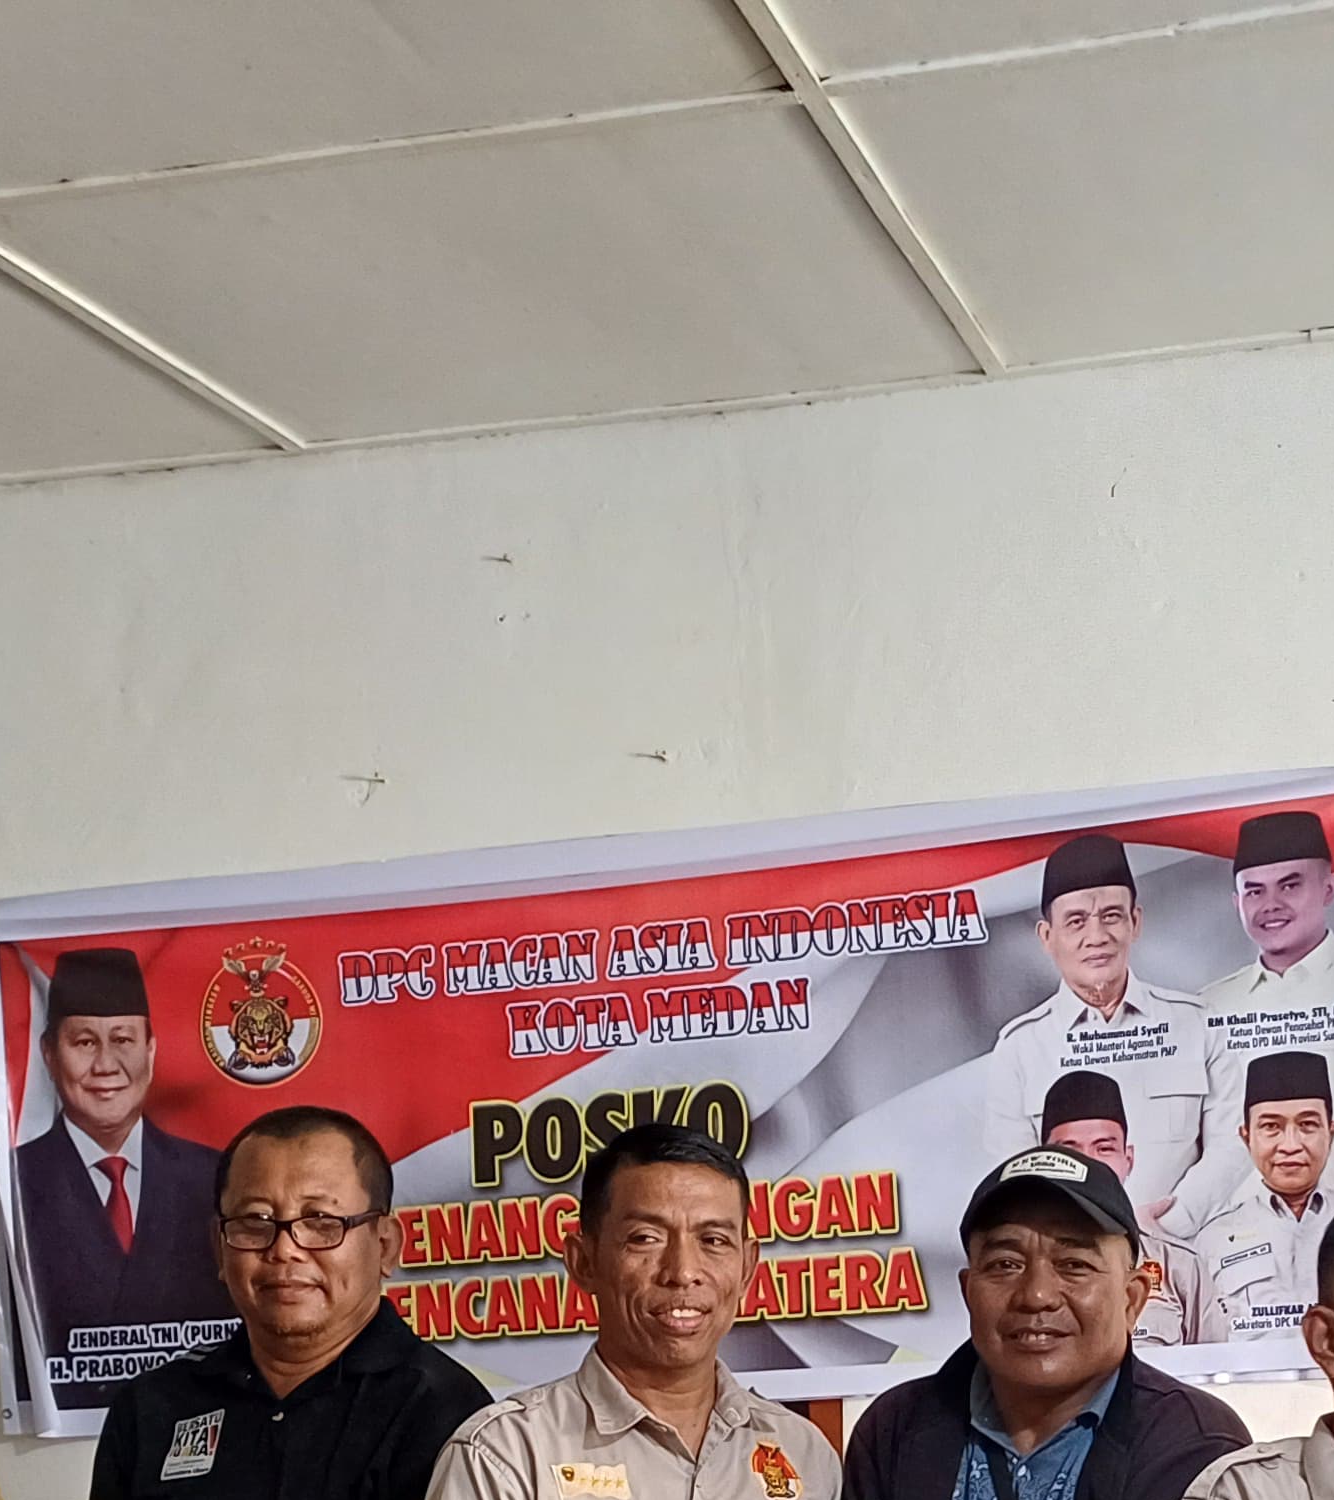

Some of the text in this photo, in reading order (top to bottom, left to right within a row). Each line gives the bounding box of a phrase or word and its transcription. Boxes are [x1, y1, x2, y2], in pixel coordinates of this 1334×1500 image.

[340, 946, 435, 1004] DPC
[445, 932, 596, 993] MACAN
[608, 919, 713, 979] ASIA
[727, 889, 988, 966] INDONESIA
[511, 978, 811, 1055] KOTA MEDAN
[70, 1327, 148, 1349] JENDERAL
[151, 1325, 179, 1345] TNI
[49, 1360, 71, 1380] H.
